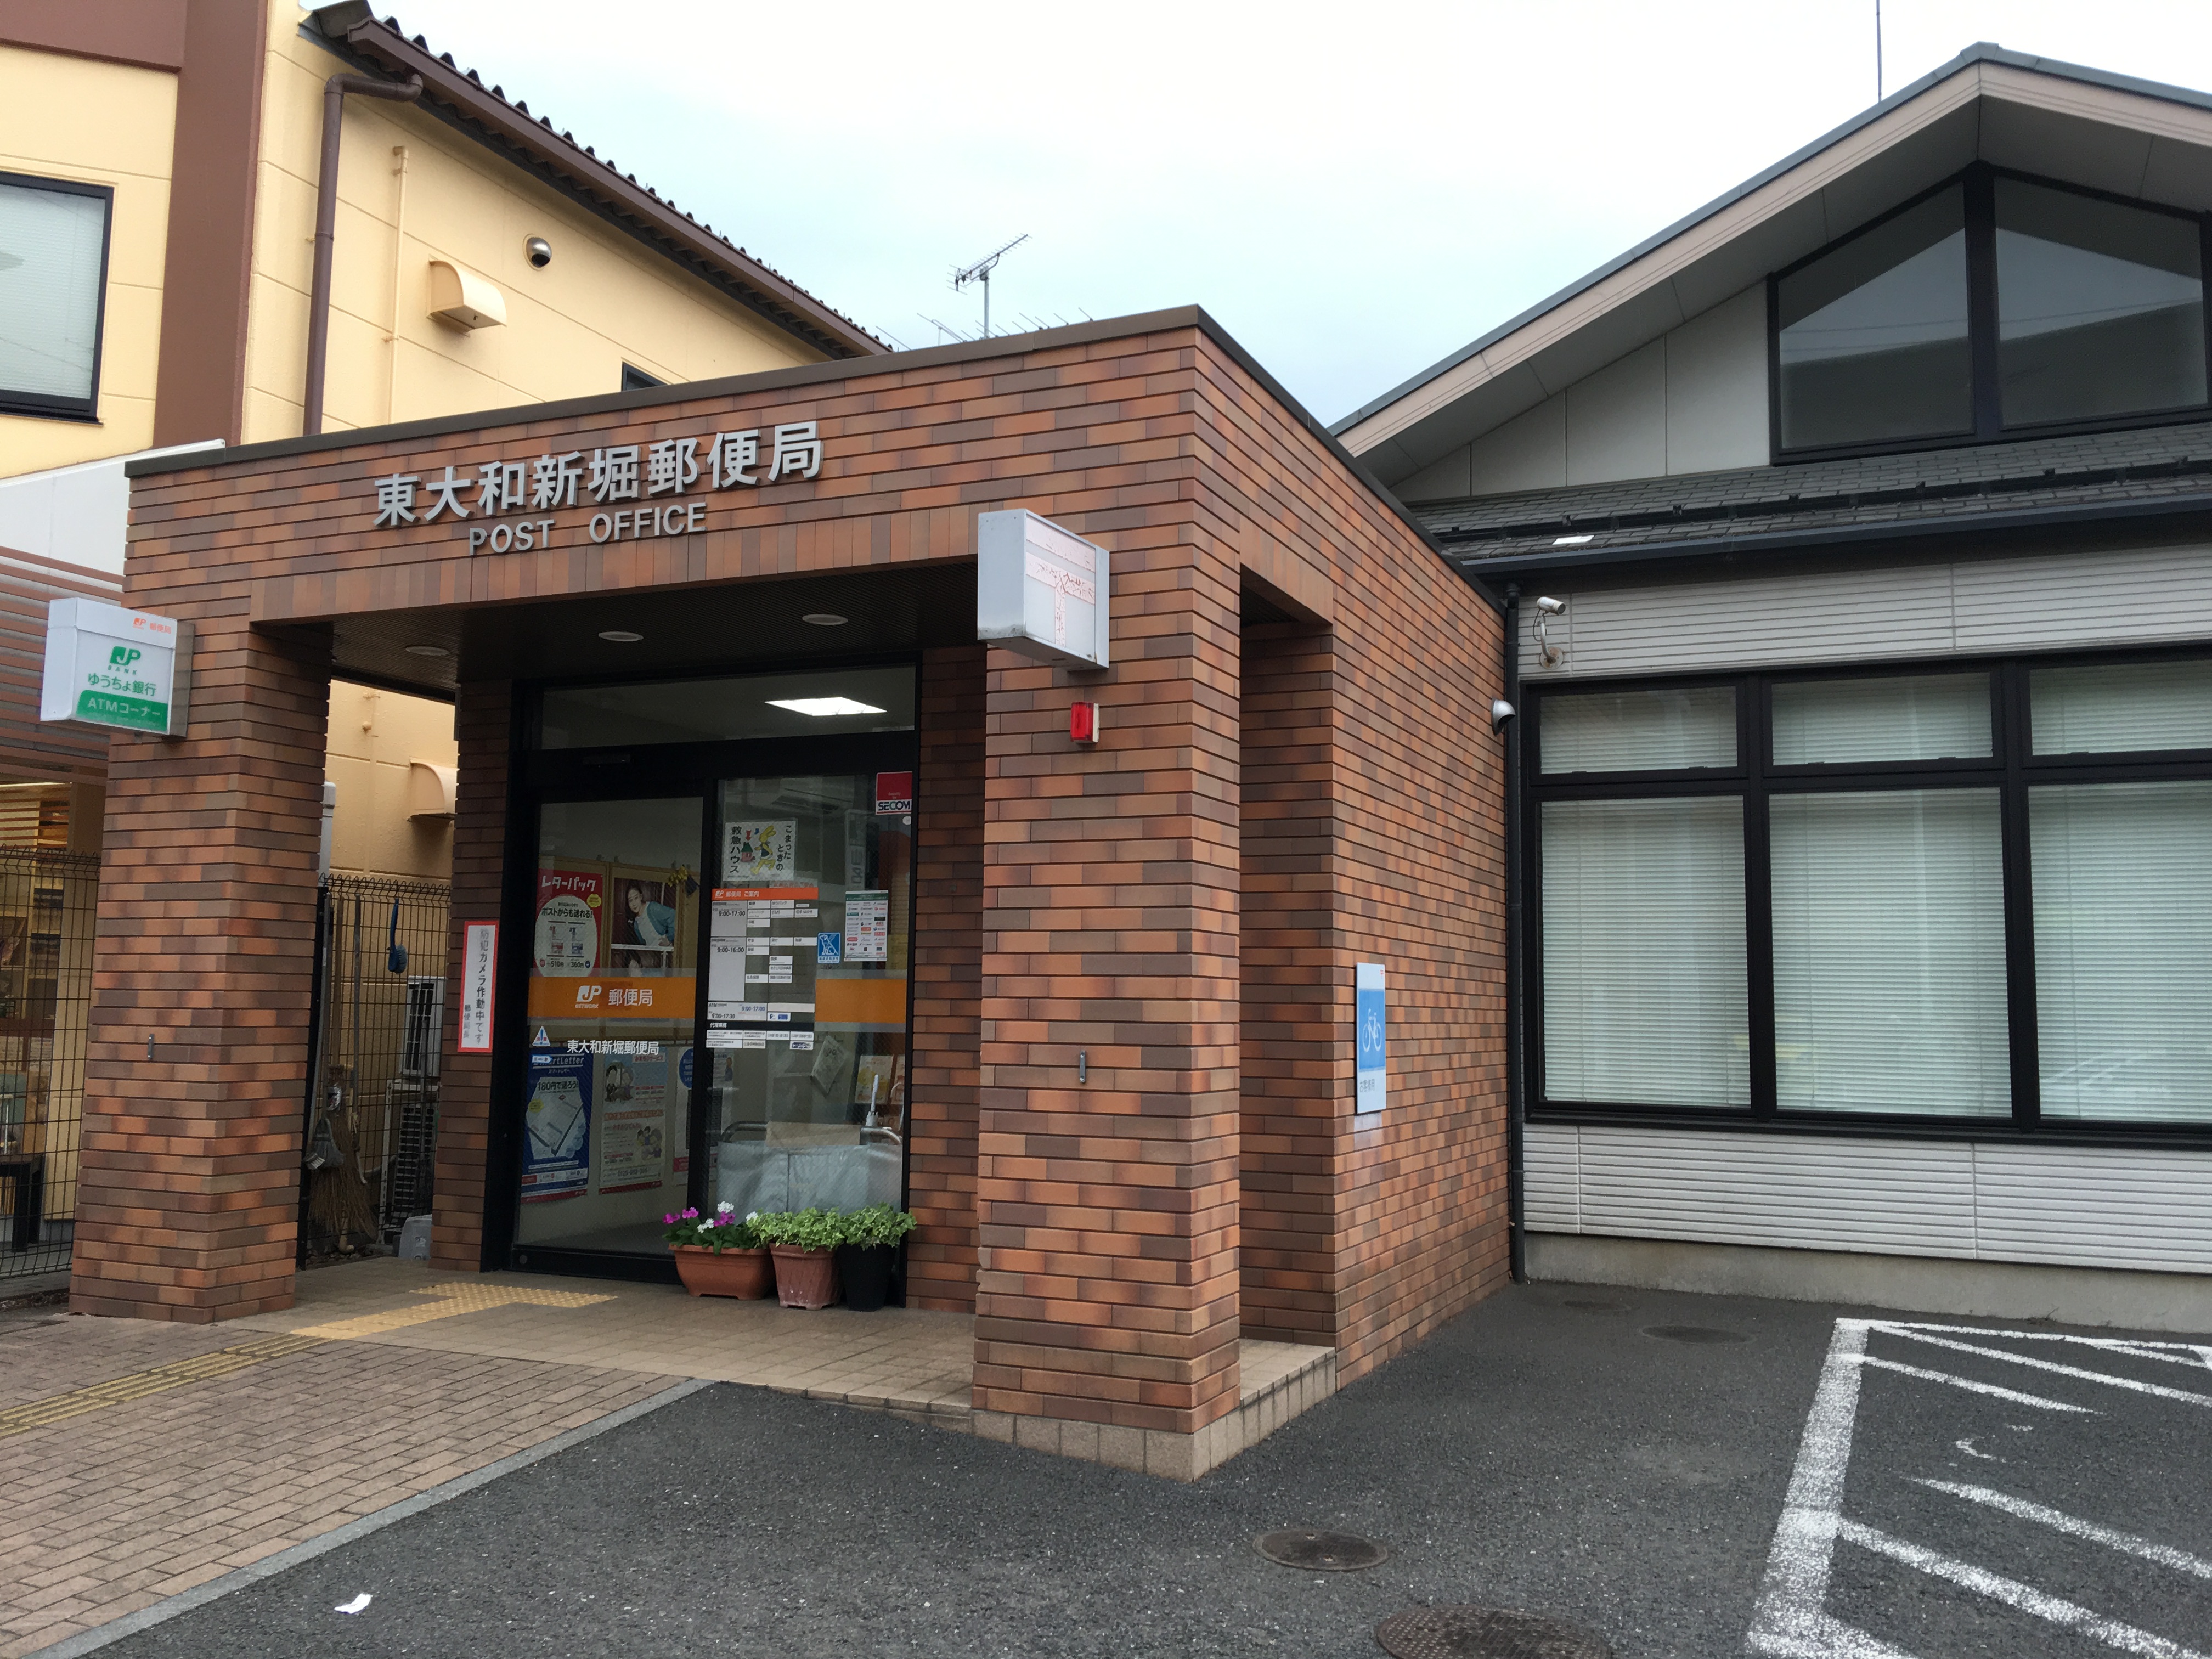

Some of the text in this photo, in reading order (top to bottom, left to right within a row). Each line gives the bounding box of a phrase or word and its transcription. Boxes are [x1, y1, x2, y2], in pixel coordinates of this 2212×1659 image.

[373, 420, 823, 527] 東大和新堀郵便局
[469, 501, 708, 555] POST OFFICE
[109, 646, 141, 666] JP
[108, 665, 138, 675] BANK
[88, 673, 156, 697] ゆうちょ銀行
[87, 697, 160, 716] ATMコーナー
[878, 801, 910, 811] SECOM
[730, 826, 742, 873] 救急ハウス
[541, 875, 596, 892] レターパック
[475, 928, 489, 1044] 防犯カメラ作動中です
[576, 985, 653, 1007] JP 郵便局
[567, 1039, 659, 1056] 東大和新堀郵便局
[533, 1056, 584, 1065] rtLetter
